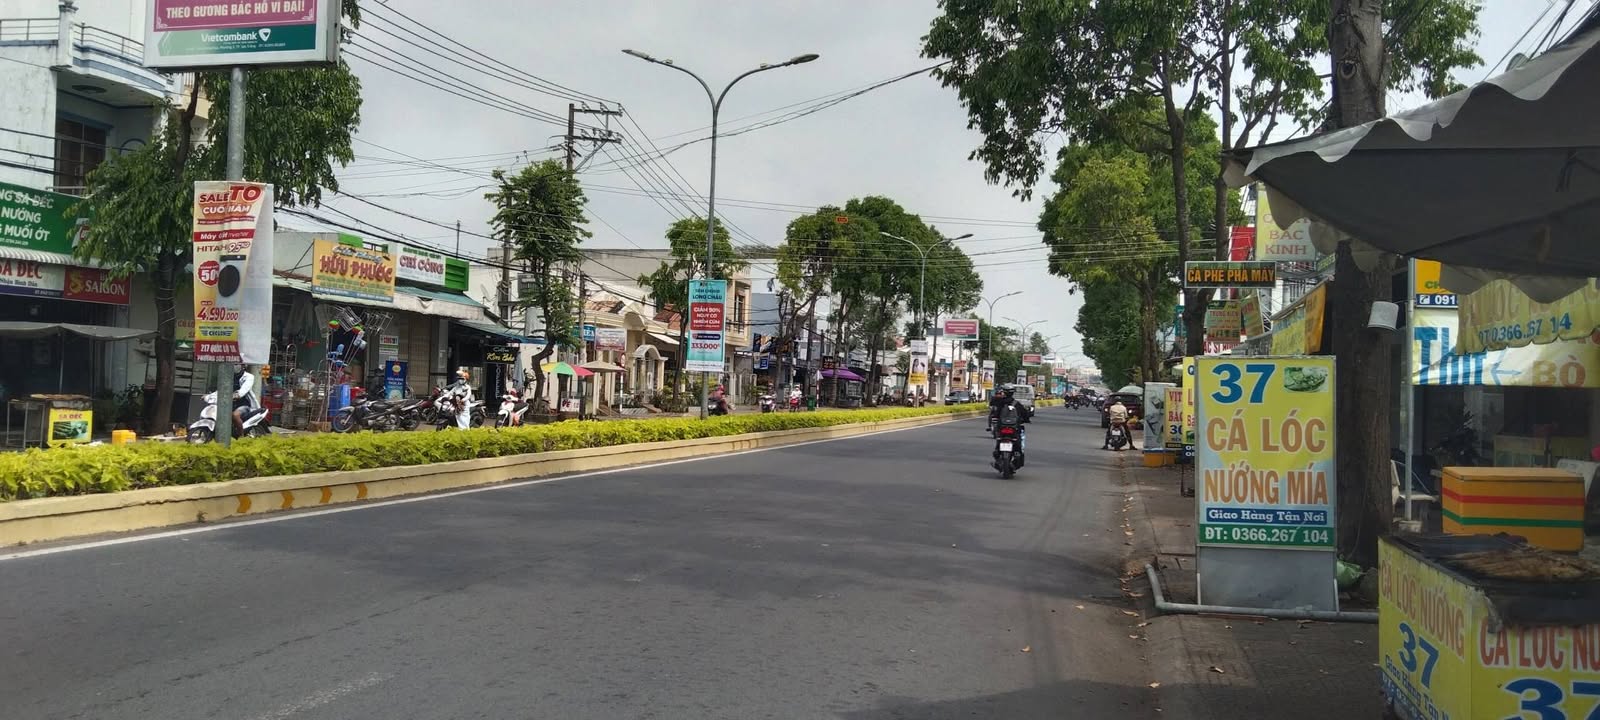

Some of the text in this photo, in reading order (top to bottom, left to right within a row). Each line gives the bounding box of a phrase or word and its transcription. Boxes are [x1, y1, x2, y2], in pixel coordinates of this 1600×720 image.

[166, 7, 190, 19] THEO
[231, 1, 251, 16] BÁC
[201, 32, 258, 42] Vietcombank
[200, 185, 261, 202] SALE TO
[1, 206, 41, 223] NƯỚNG
[4, 224, 50, 241] MUỐI ỚT
[1265, 245, 1306, 255] KINH
[201, 269, 219, 282] 50
[1211, 364, 1275, 404] 37
[1207, 409, 1326, 452] CÁ LÓC
[1204, 461, 1328, 505] NƯỚNG MÍA
[1208, 510, 1325, 523] Giao Hàng Tận Nơi
[1205, 527, 1329, 543] ĐT: 0366.267 104
[1399, 622, 1439, 689] 37
